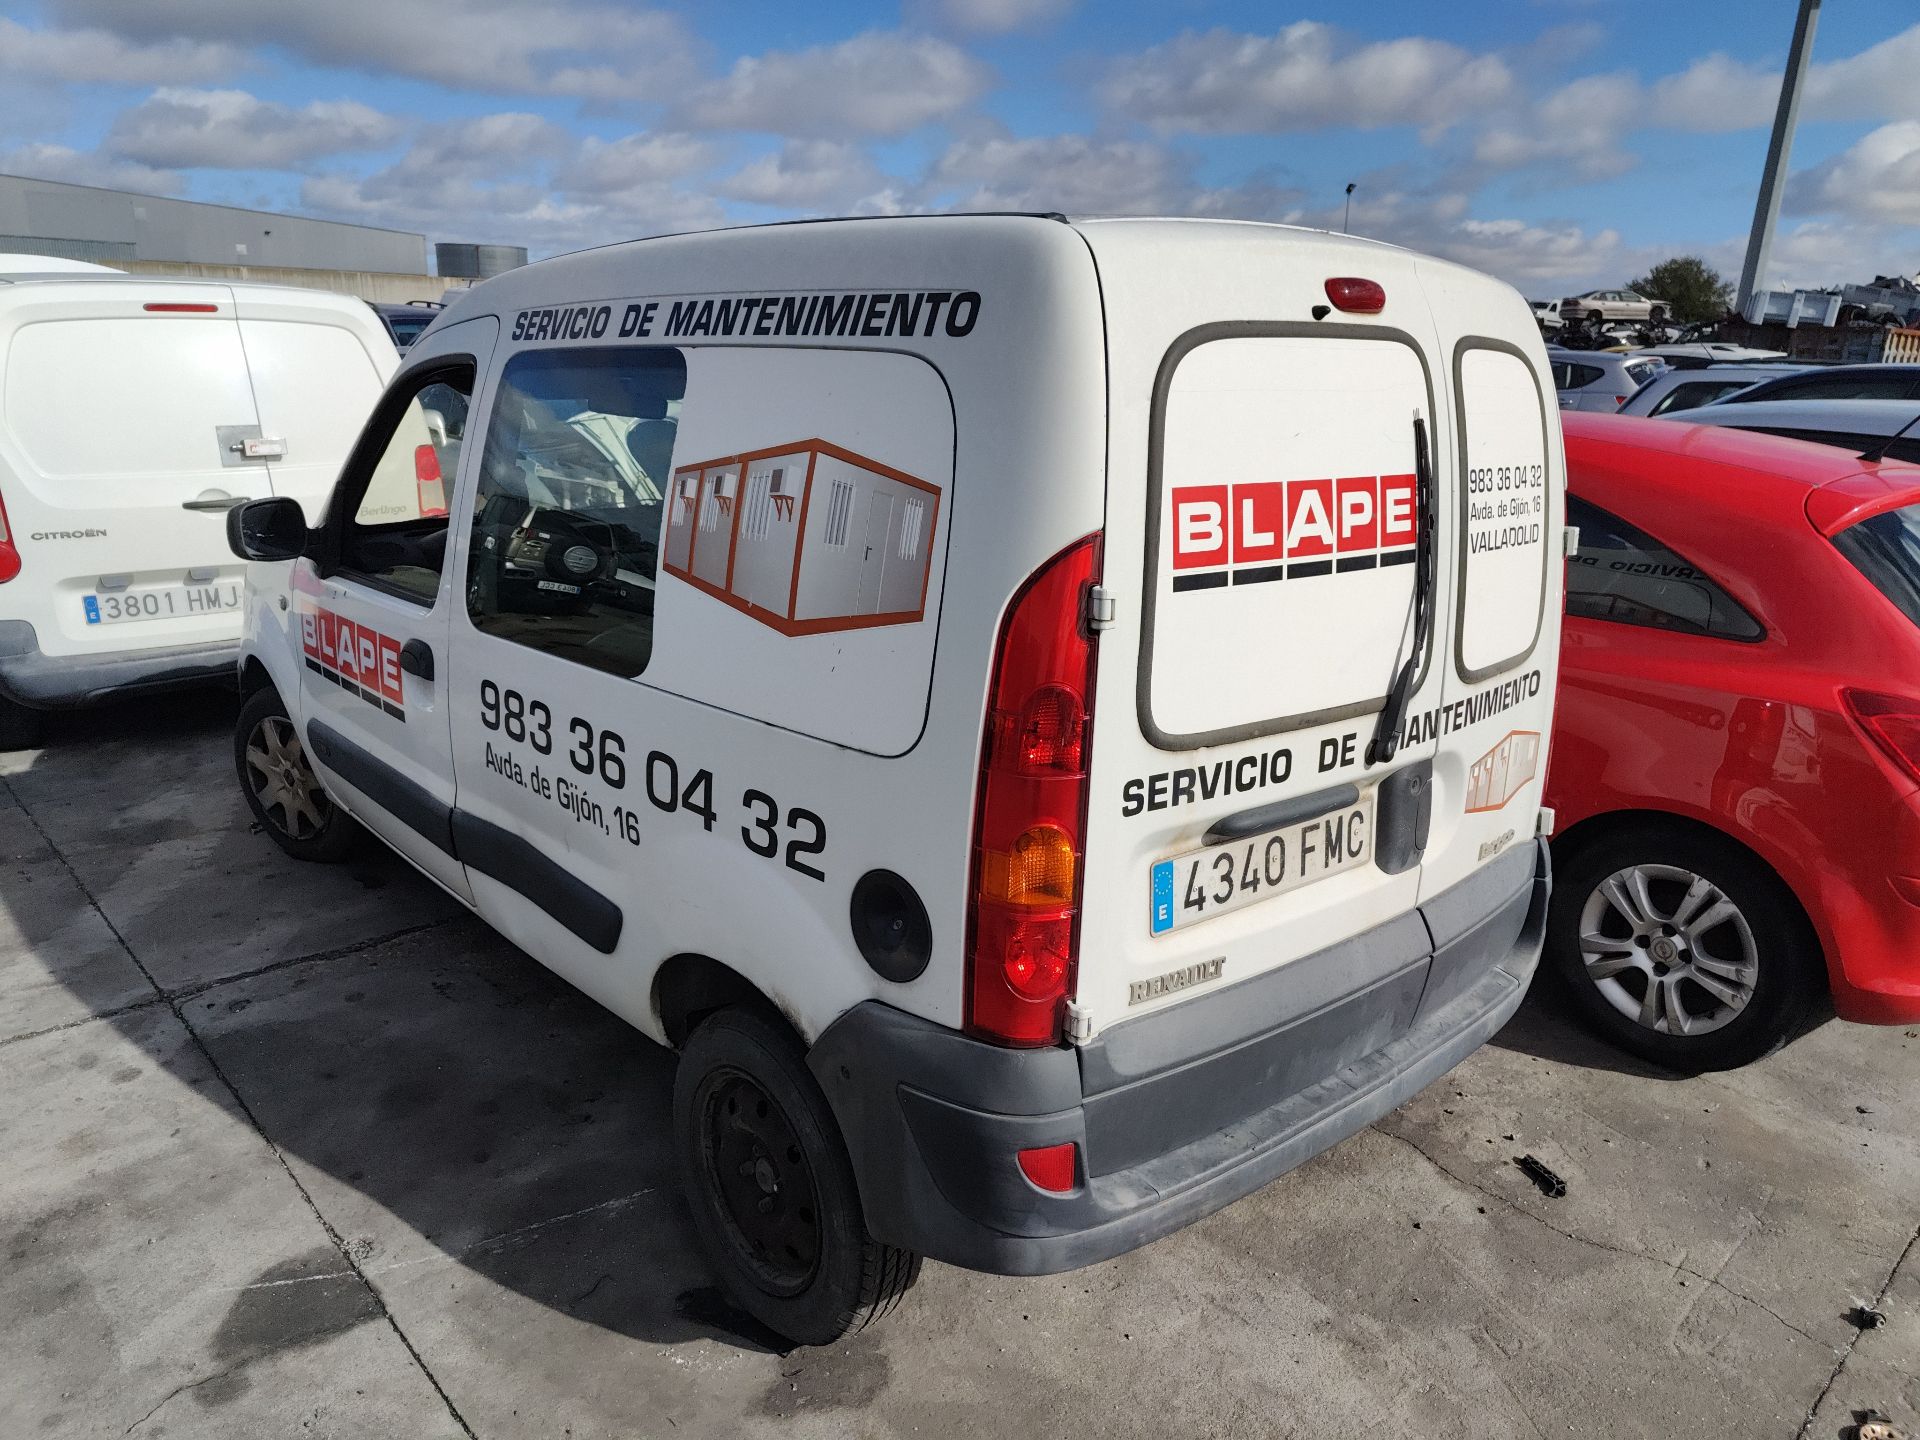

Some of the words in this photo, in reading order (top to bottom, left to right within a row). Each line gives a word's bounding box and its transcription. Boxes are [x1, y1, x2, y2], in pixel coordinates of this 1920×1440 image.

[511, 304, 611, 342] SERVICIO
[618, 302, 659, 338] DE
[664, 291, 982, 338] MANTENIMIENTO
[1469, 468, 1493, 494] 983
[1497, 466, 1511, 491] 36
[1514, 465, 1527, 489] 04
[1530, 464, 1542, 488] 32
[360, 505, 407, 517] Berlingo
[1178, 487, 1412, 554] BLAPE
[1470, 501, 1495, 521] Avda.
[1497, 499, 1508, 518] de
[1510, 497, 1531, 519] Gijón,
[1533, 495, 1541, 513] 16
[31, 528, 107, 541] CITROËN
[1470, 523, 1540, 554] VALLADOLID
[89, 612, 97, 620] E
[105, 591, 174, 619] 3801
[186, 586, 239, 612] HMJ
[302, 612, 400, 692] BLAPE
[480, 679, 553, 756] 983
[569, 717, 626, 790] 36
[646, 750, 718, 833] 04
[741, 788, 827, 883] 32
[485, 741, 528, 789] Avda.
[531, 765, 552, 801] de
[556, 776, 610, 836] Gijón,
[613, 805, 641, 847] 16
[1122, 748, 1293, 817] SERVICIO
[1318, 733, 1358, 773] DE
[1158, 903, 1169, 921] E
[1183, 835, 1287, 912] 4340
[1300, 810, 1364, 877] FMC
[1128, 955, 1227, 1006] RENAULT
